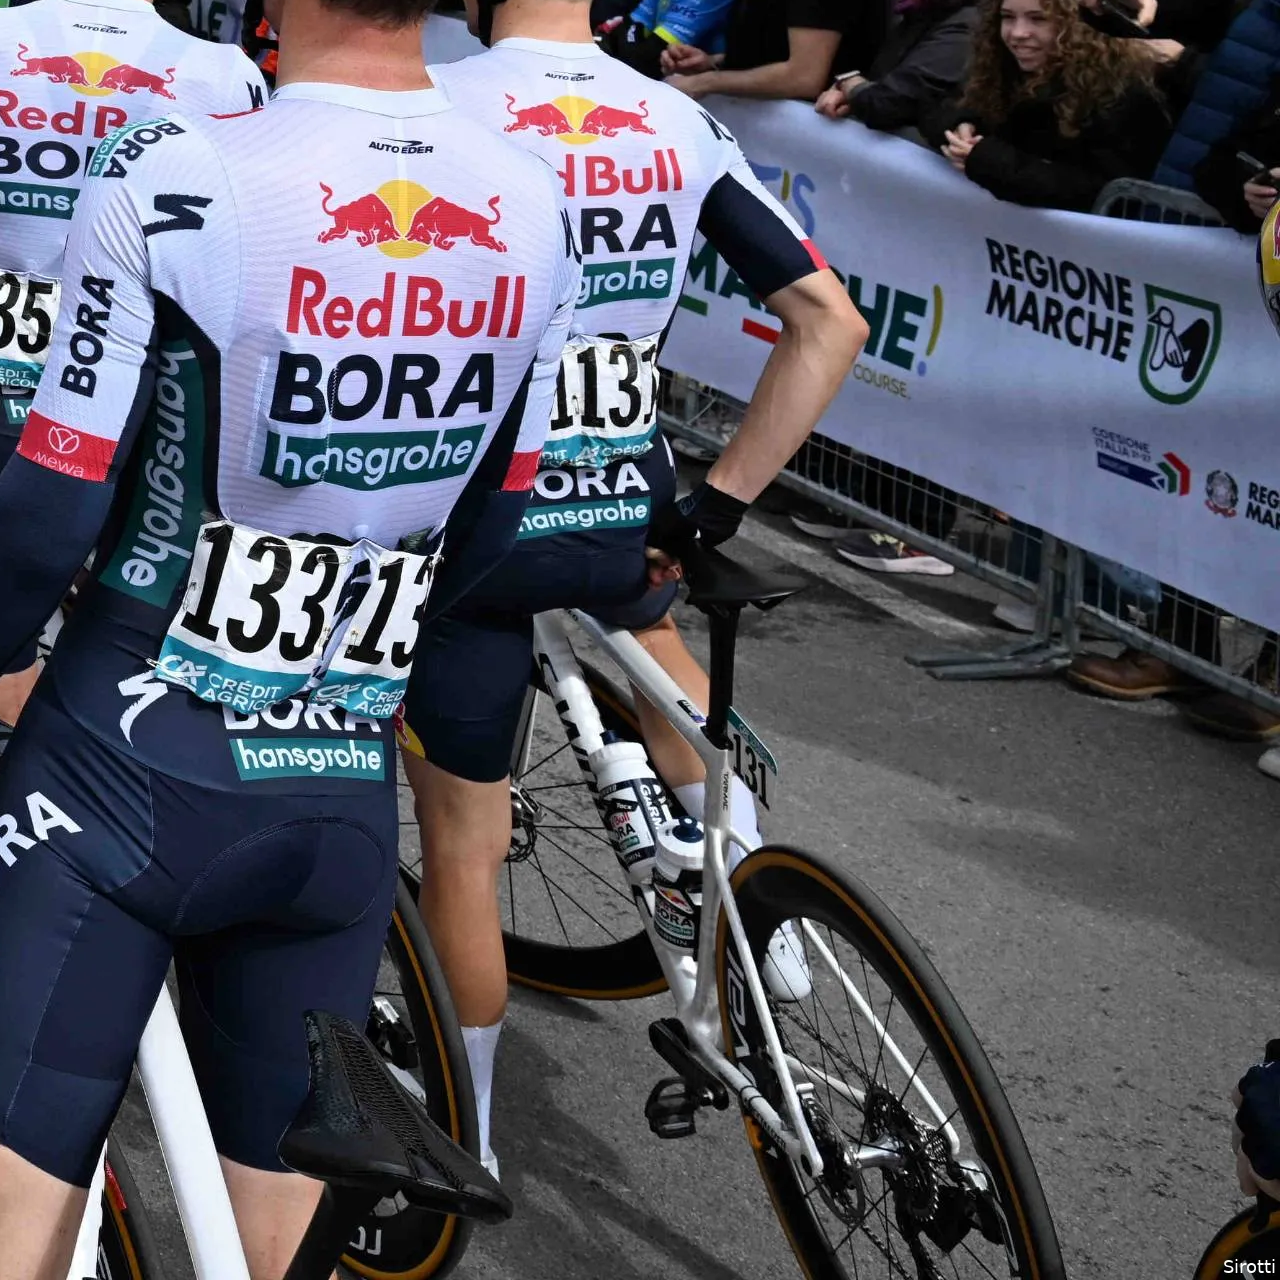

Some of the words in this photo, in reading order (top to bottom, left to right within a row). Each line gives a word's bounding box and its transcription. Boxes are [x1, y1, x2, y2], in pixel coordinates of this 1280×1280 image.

[72, 22, 99, 33] AUTO
[99, 25, 128, 36] EDER
[544, 71, 570, 81] AUTO
[569, 73, 595, 83] EDER
[102, 120, 188, 181] BORA
[368, 140, 402, 152] AUTO
[401, 143, 435, 155] EDER
[584, 146, 684, 196] Bull
[579, 204, 678, 257] RA
[285, 265, 397, 340] Red
[401, 273, 528, 340] Bull
[984, 237, 1136, 318] REGIONE
[59, 274, 116, 399] BORA
[984, 278, 1136, 364] MARCHE
[267, 351, 496, 425] BORA
[120, 346, 197, 588] hansgrohe
[274, 426, 474, 485] hansgrohe
[1091, 426, 1152, 455] COESIONE
[1094, 437, 1130, 460] ITALIA
[533, 462, 651, 500] ORA
[180, 525, 341, 662] 133
[208, 672, 282, 700] CRÉDIT
[238, 738, 382, 773] hansgrohe
[733, 733, 770, 812] 131
[721, 772, 730, 812] TARMAC
